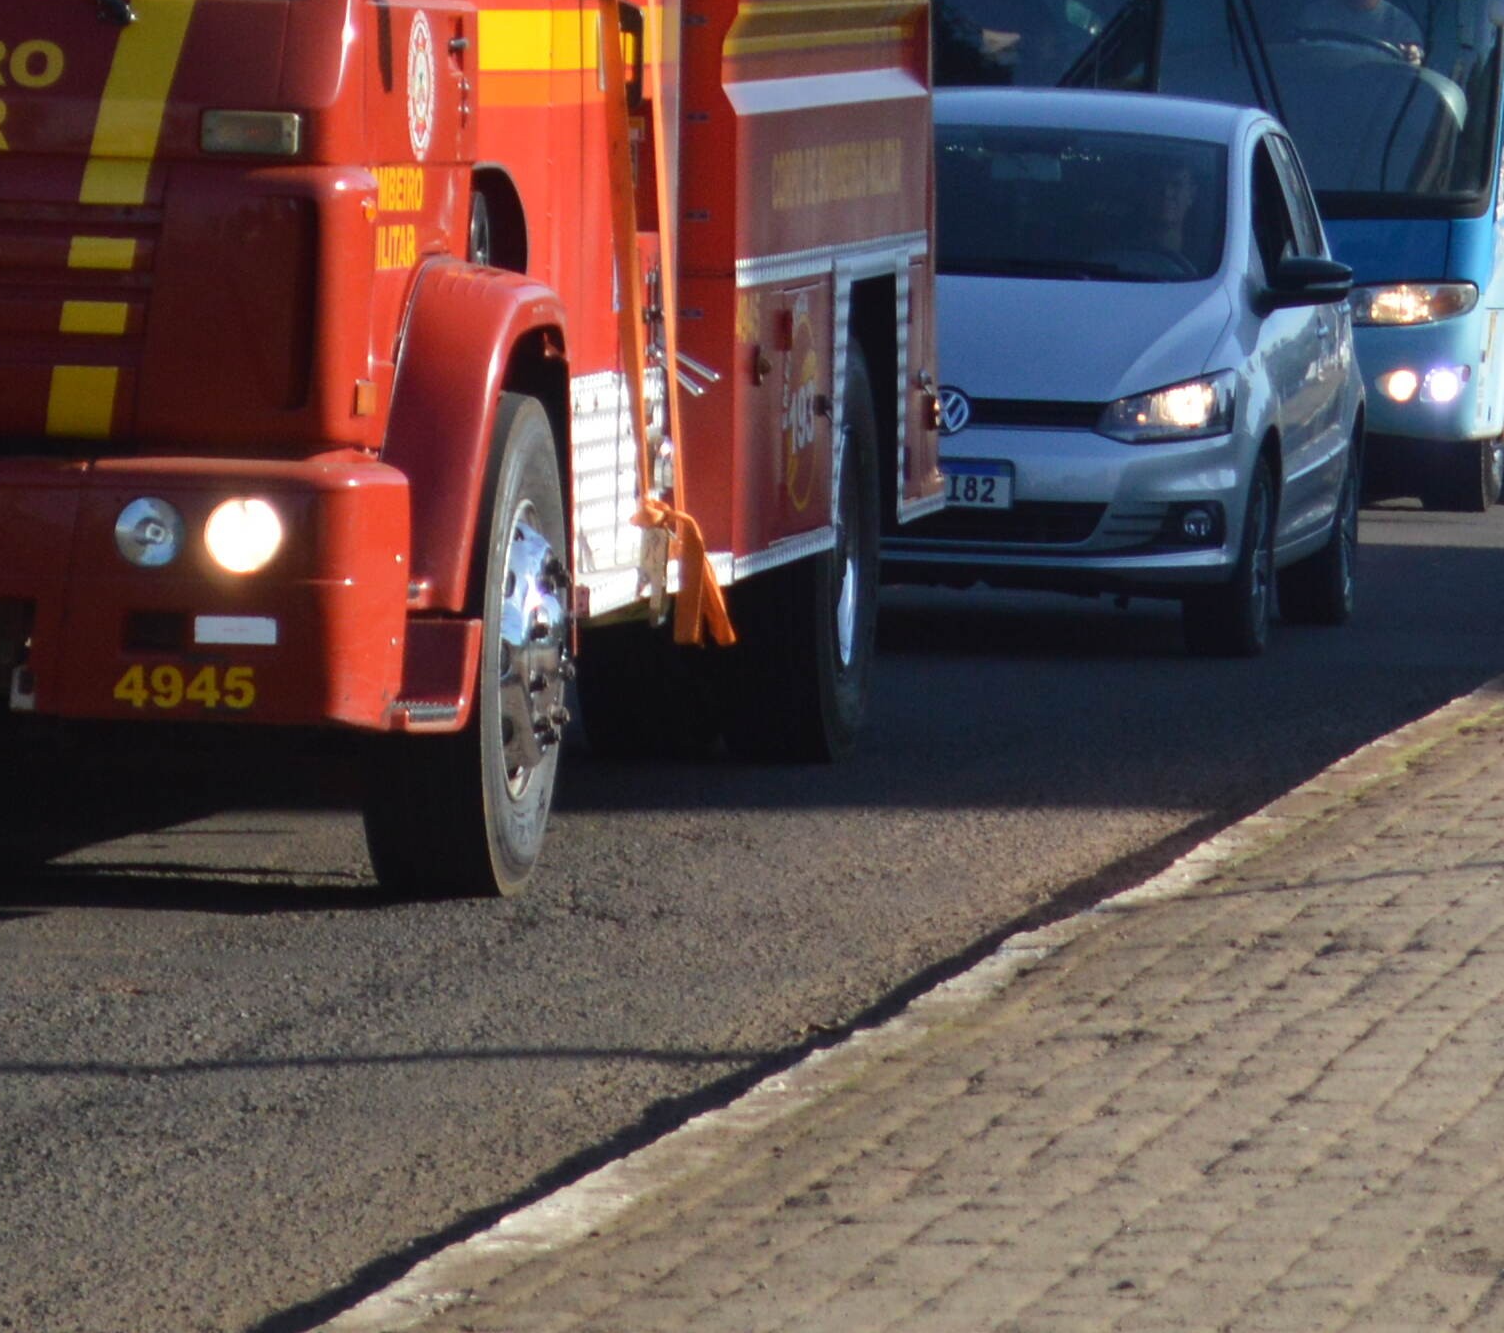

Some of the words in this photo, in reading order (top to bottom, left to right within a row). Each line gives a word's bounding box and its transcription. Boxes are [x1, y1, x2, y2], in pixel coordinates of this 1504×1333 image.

[367, 167, 424, 212] MBEIRO
[376, 224, 417, 271] ILITAR
[946, 475, 995, 503] I82
[113, 664, 256, 710] 4945
